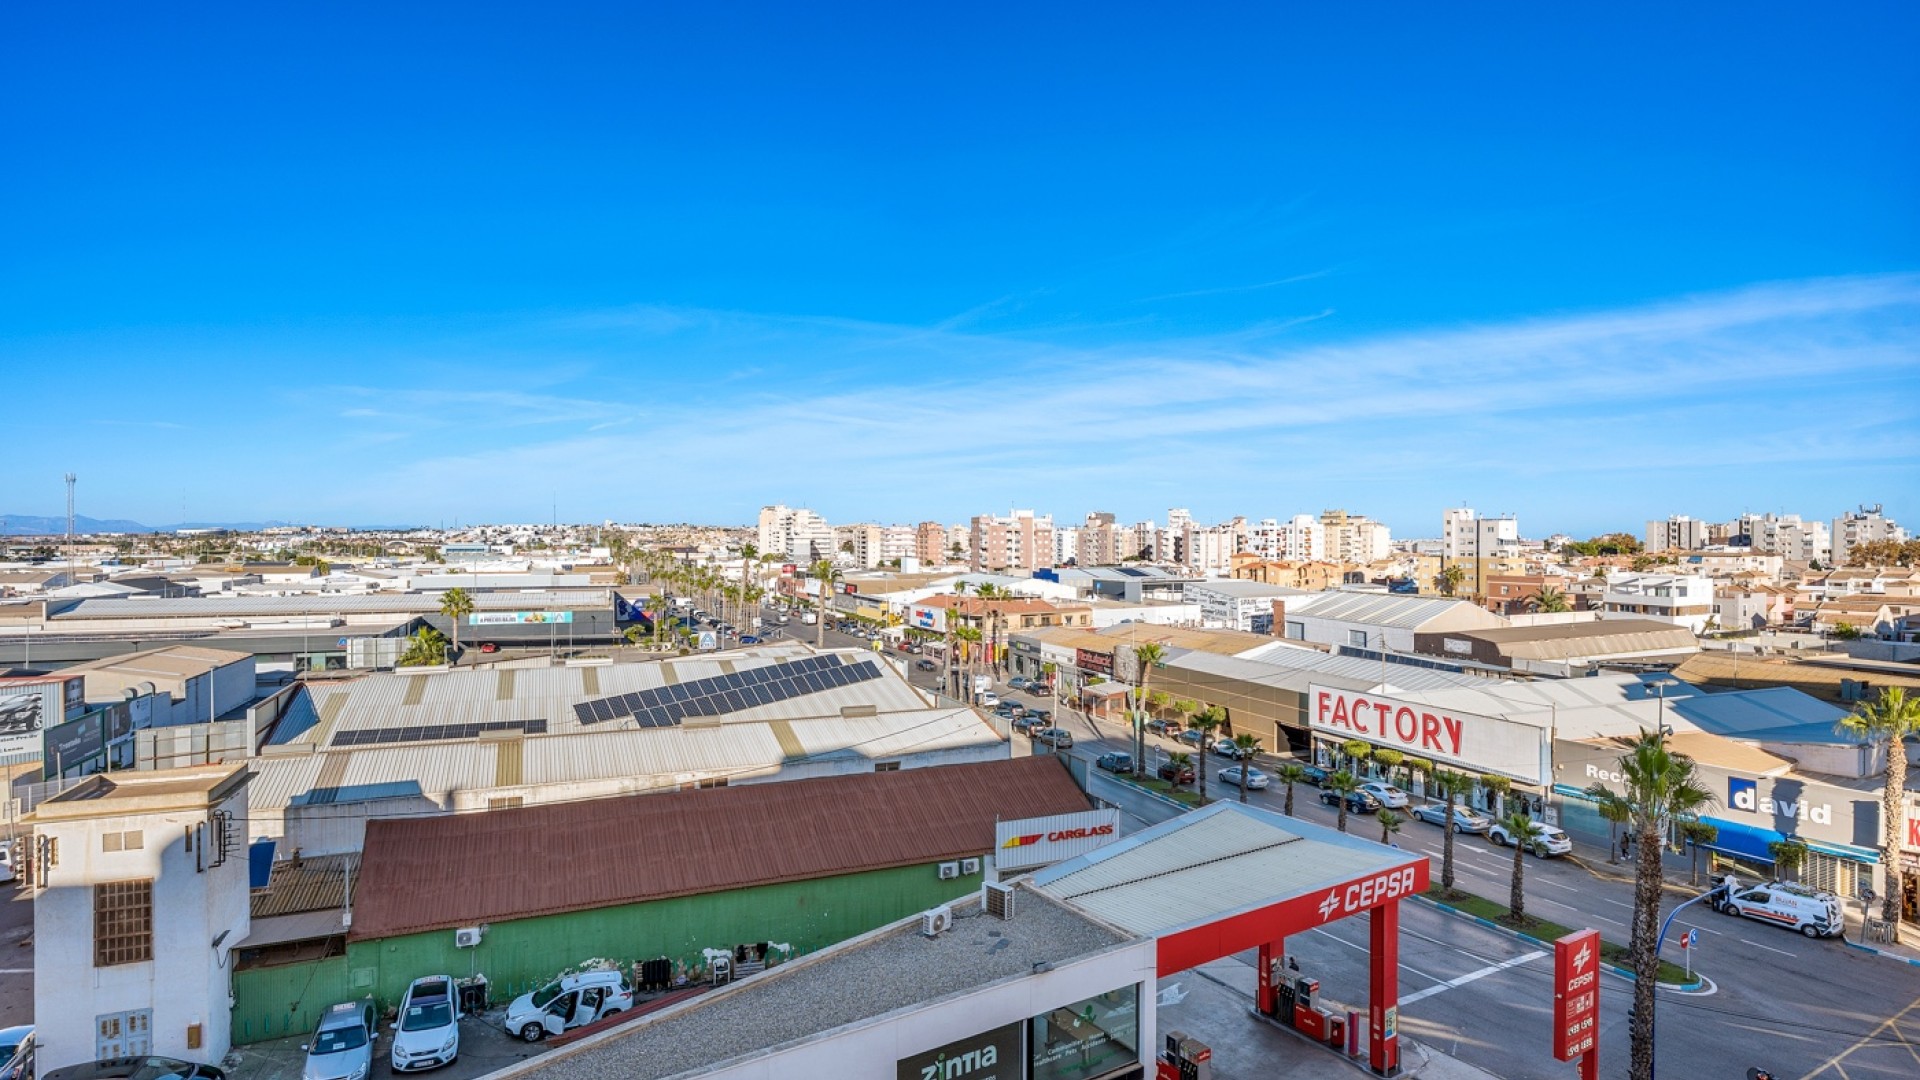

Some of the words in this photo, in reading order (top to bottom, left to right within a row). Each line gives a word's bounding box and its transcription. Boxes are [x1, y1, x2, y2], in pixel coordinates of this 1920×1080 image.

[1318, 691, 1463, 756] FACTORY
[1734, 788, 1832, 825] david
[1048, 824, 1114, 843] CARGLASS
[1344, 867, 1415, 912] CEPSA
[1568, 971, 1594, 991] CEPSA
